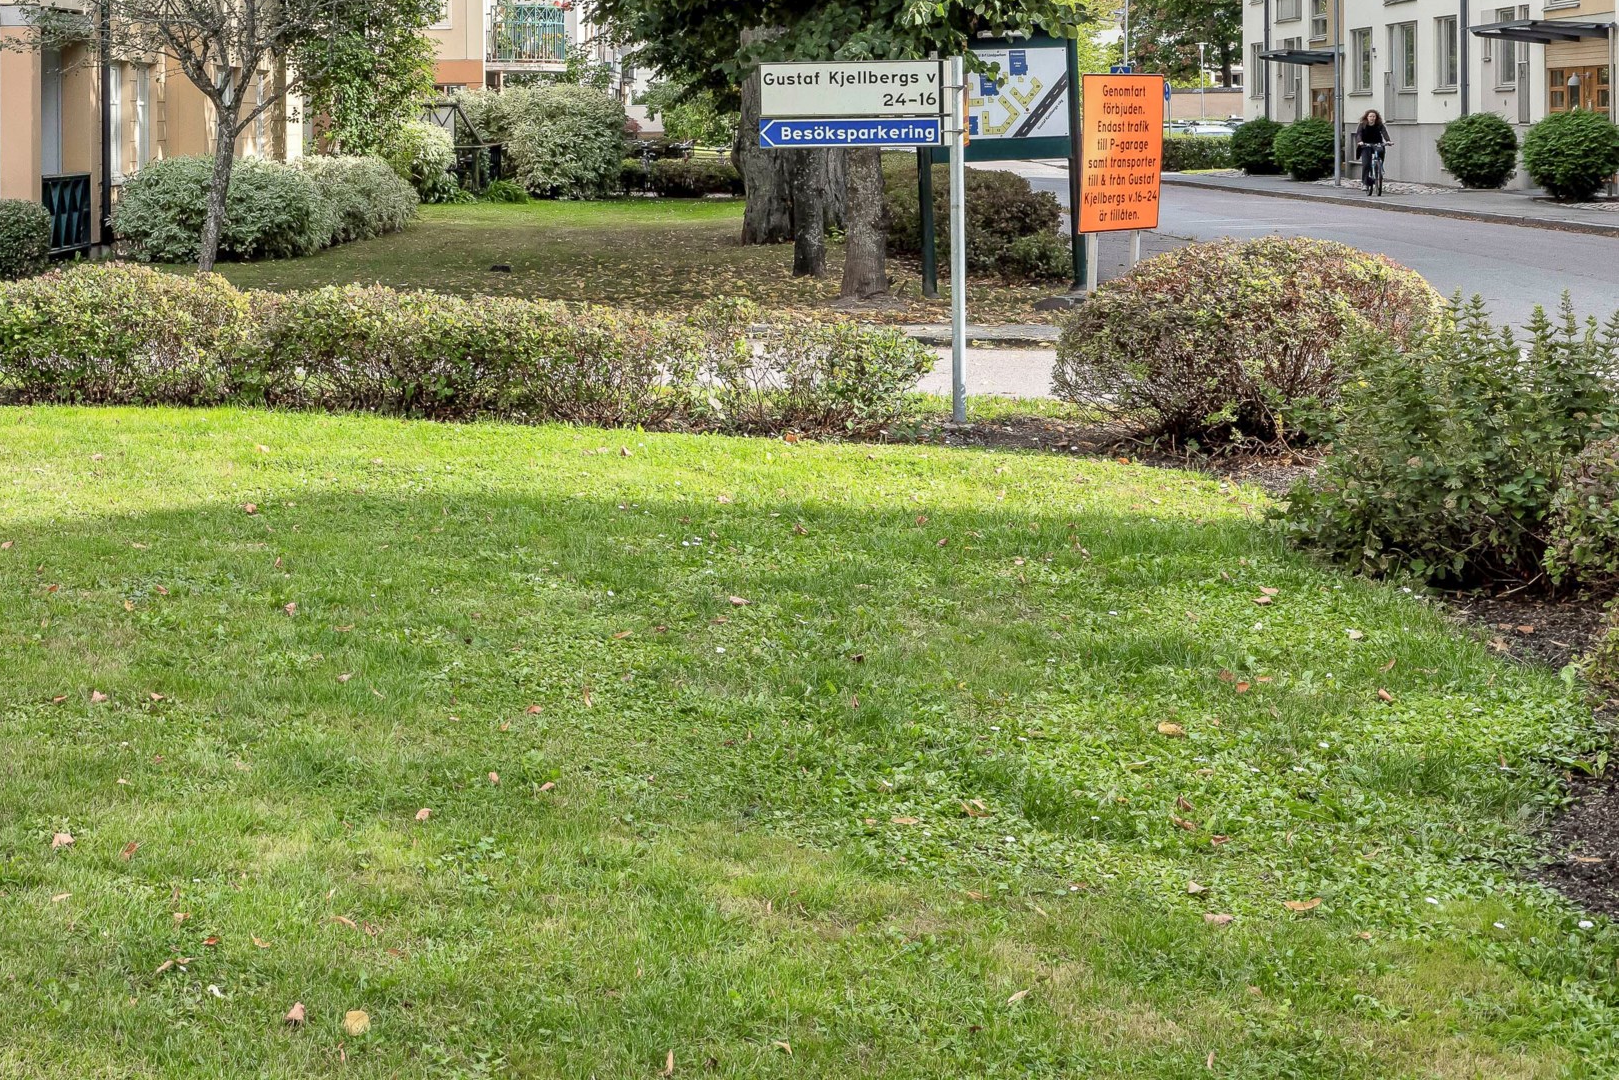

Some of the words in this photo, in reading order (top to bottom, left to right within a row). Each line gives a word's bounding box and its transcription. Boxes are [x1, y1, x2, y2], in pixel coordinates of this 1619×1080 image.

[763, 72, 820, 86] Gustaf
[829, 71, 920, 87] Kjellbergs
[926, 73, 937, 84] v
[1102, 84, 1146, 97] Genomfart
[883, 92, 937, 107] 24-16
[1103, 102, 1146, 117] förbjuden.
[780, 124, 935, 142] Besöksparkering
[1097, 120, 1125, 133] Endast
[1127, 120, 1150, 133] trafik
[1097, 138, 1108, 151] till
[1110, 138, 1149, 153] P-garage
[1088, 156, 1108, 169] samt
[1110, 155, 1157, 170] transporter
[1088, 173, 1099, 187] till
[1100, 174, 1107, 186] &
[1109, 173, 1126, 186] från
[1128, 172, 1155, 185] Gustaf
[1084, 191, 1126, 207] Kjellbergs
[1098, 209, 1108, 222] är
[1110, 208, 1140, 222] tillåten.
